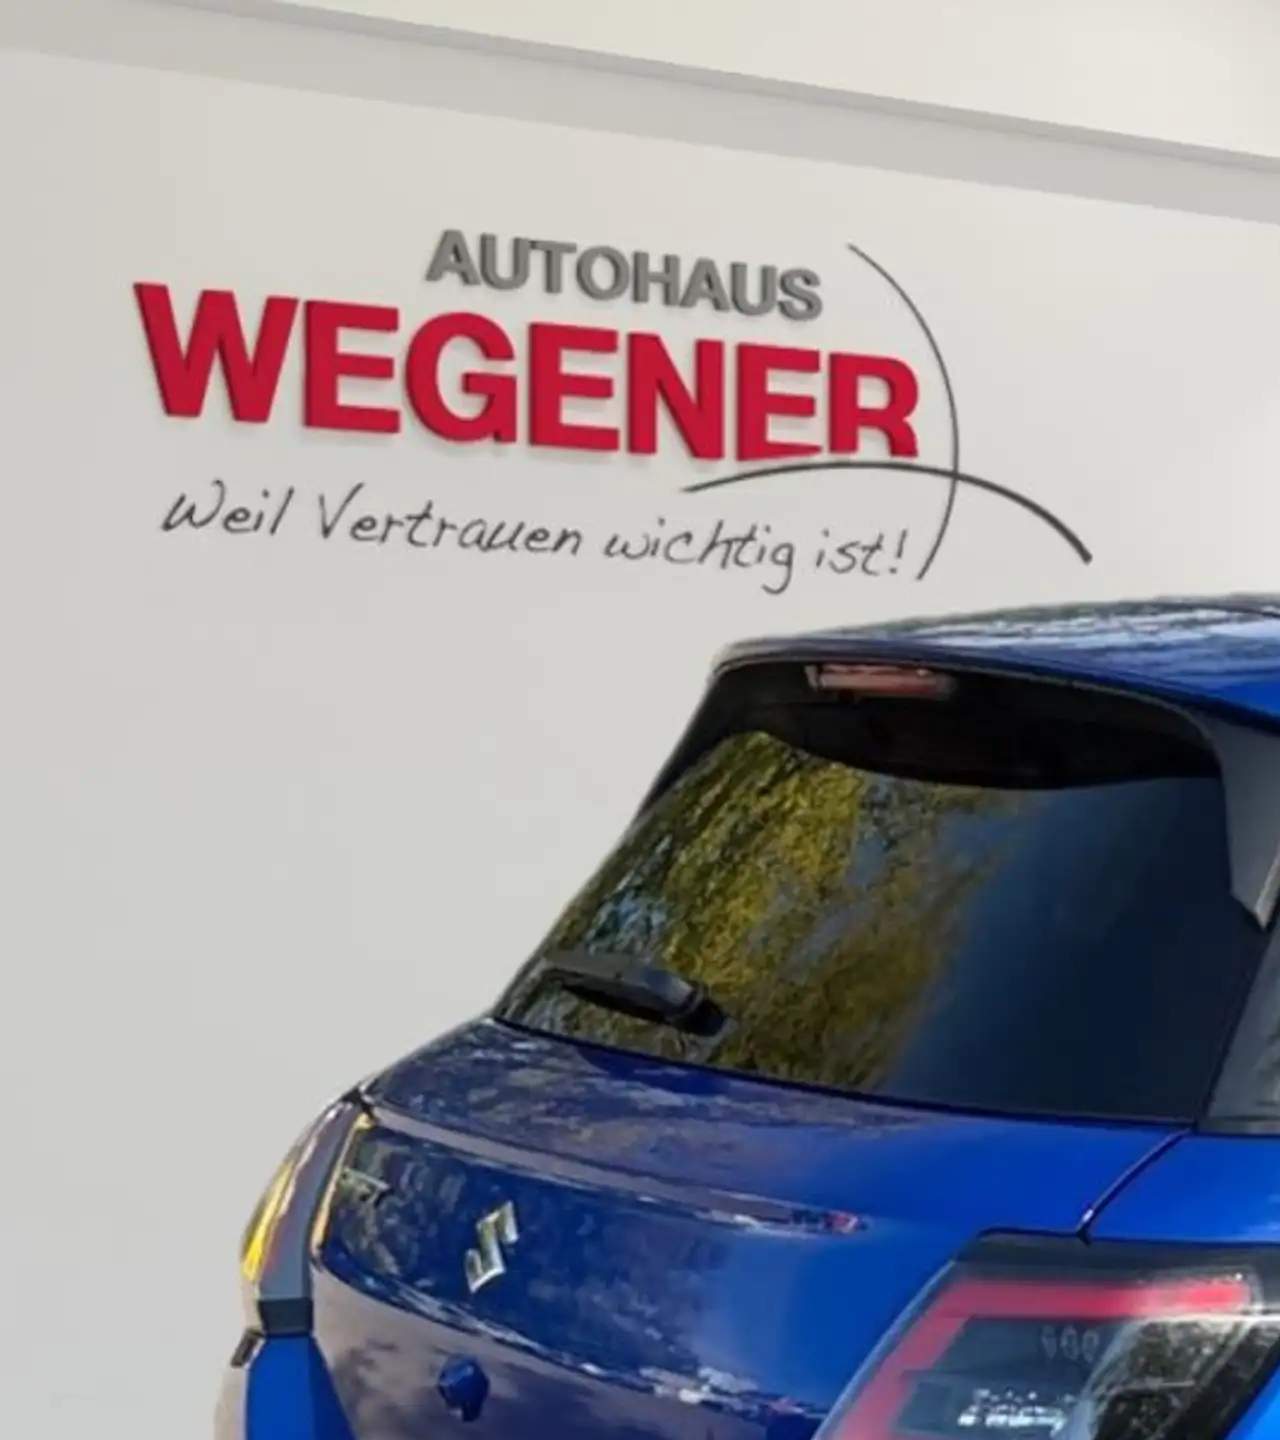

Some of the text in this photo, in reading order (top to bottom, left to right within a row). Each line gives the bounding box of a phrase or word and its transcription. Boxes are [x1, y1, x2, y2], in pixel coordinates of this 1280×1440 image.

[425, 229, 823, 322] AUTOHAUS
[133, 281, 920, 463] WEGENER
[161, 479, 910, 596] Weil Vertrauen wichtig ist!
